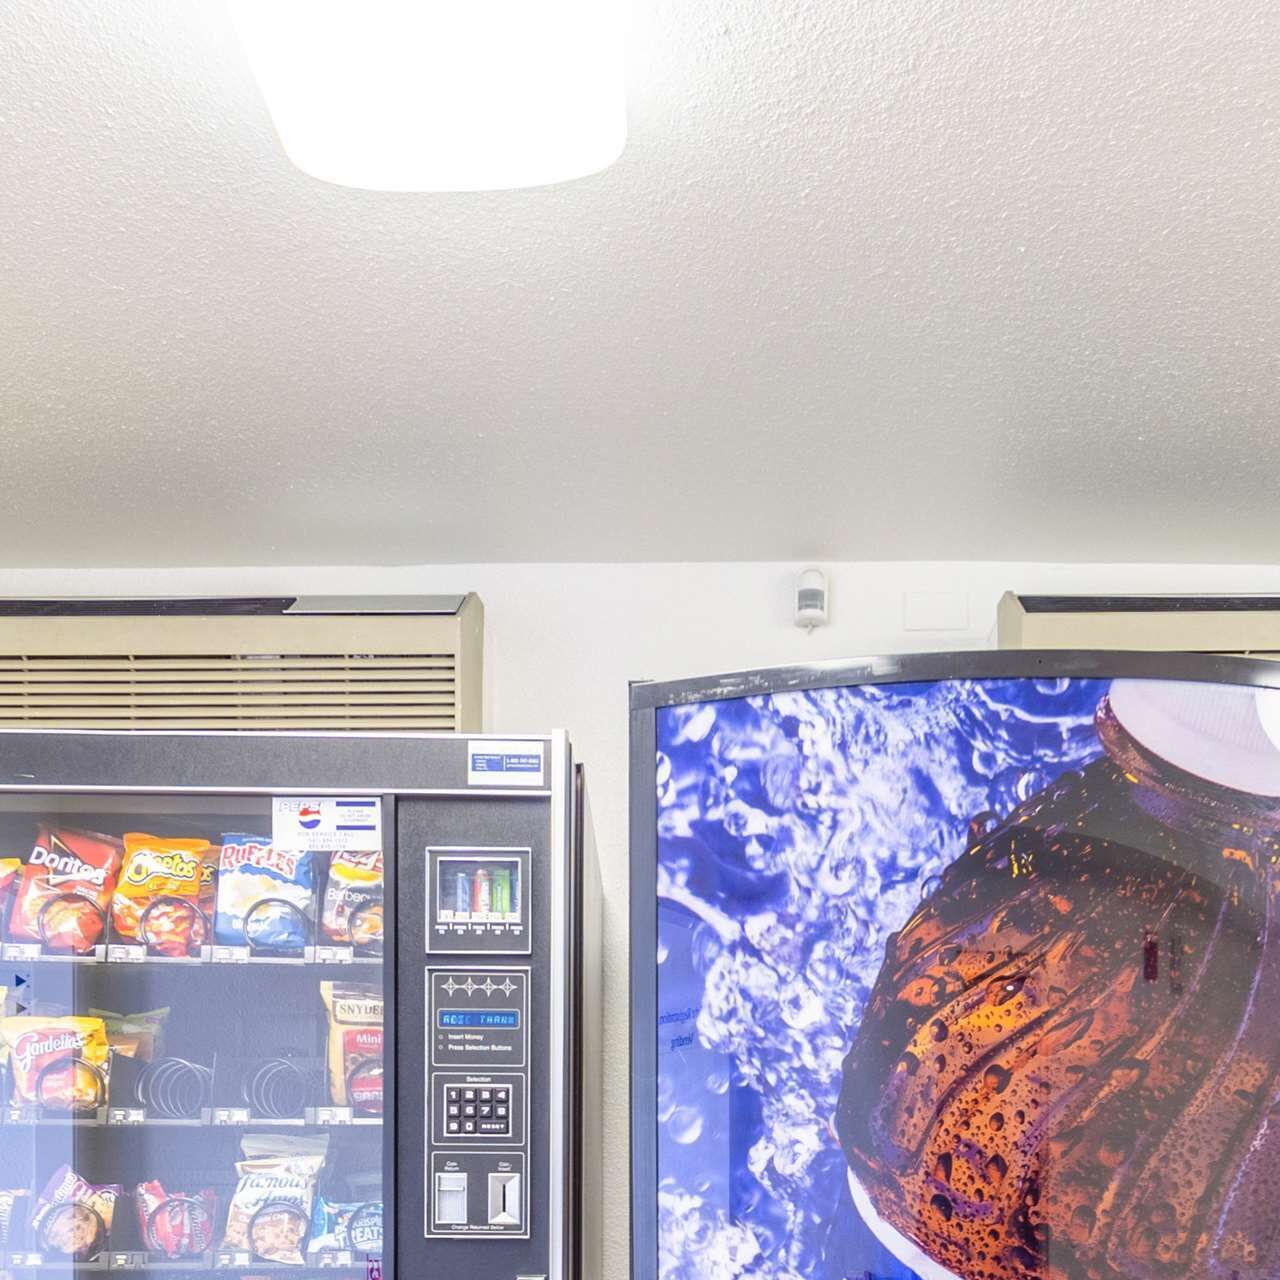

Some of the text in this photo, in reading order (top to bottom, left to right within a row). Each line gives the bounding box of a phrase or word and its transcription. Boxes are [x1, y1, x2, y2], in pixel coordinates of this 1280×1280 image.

[29, 846, 107, 884] Doritos
[221, 844, 296, 877] RUFFLES
[356, 1033, 382, 1044] Mini
[497, 1091, 506, 1099] 4
[466, 1106, 474, 1114] 6
[481, 1106, 490, 1115] 7
[466, 1122, 473, 1130] 0
